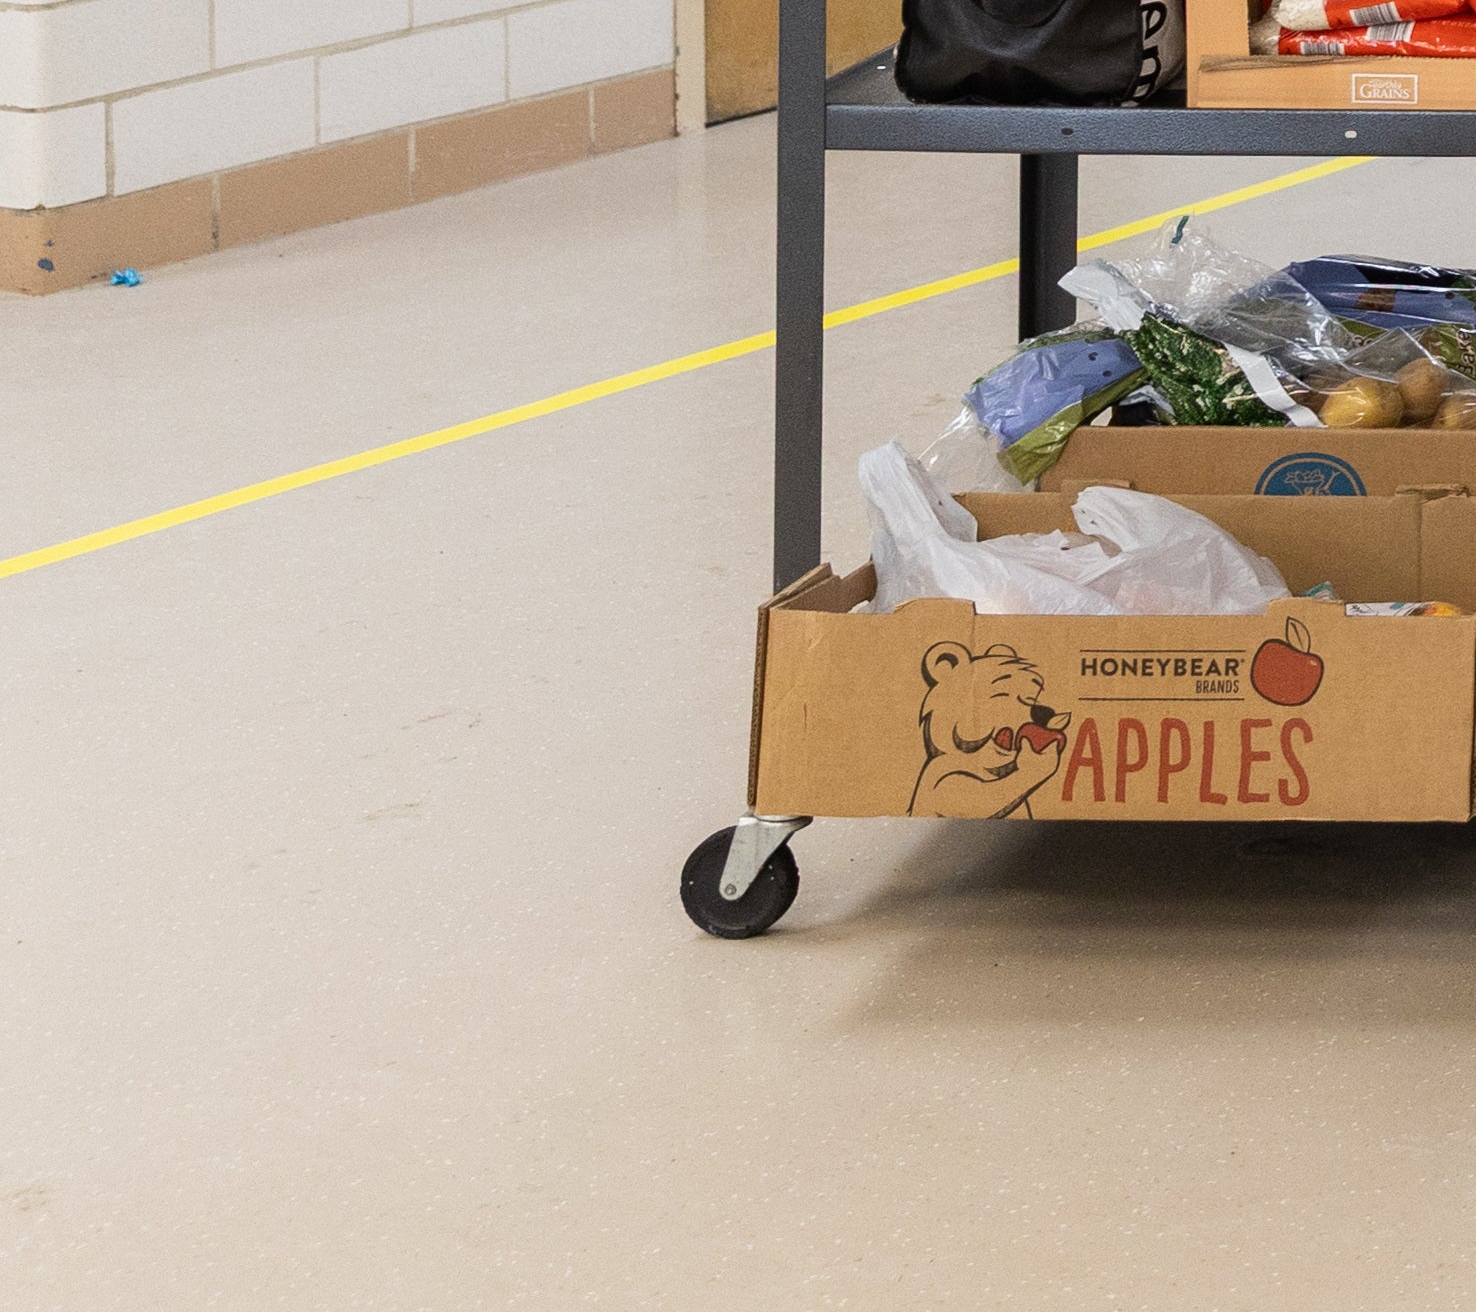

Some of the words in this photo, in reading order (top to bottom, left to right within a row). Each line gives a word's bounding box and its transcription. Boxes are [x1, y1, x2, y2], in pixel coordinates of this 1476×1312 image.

[1358, 82, 1411, 100] GRAINS
[1195, 679, 1241, 695] BRANDS
[1060, 716, 1314, 807] APPLES
